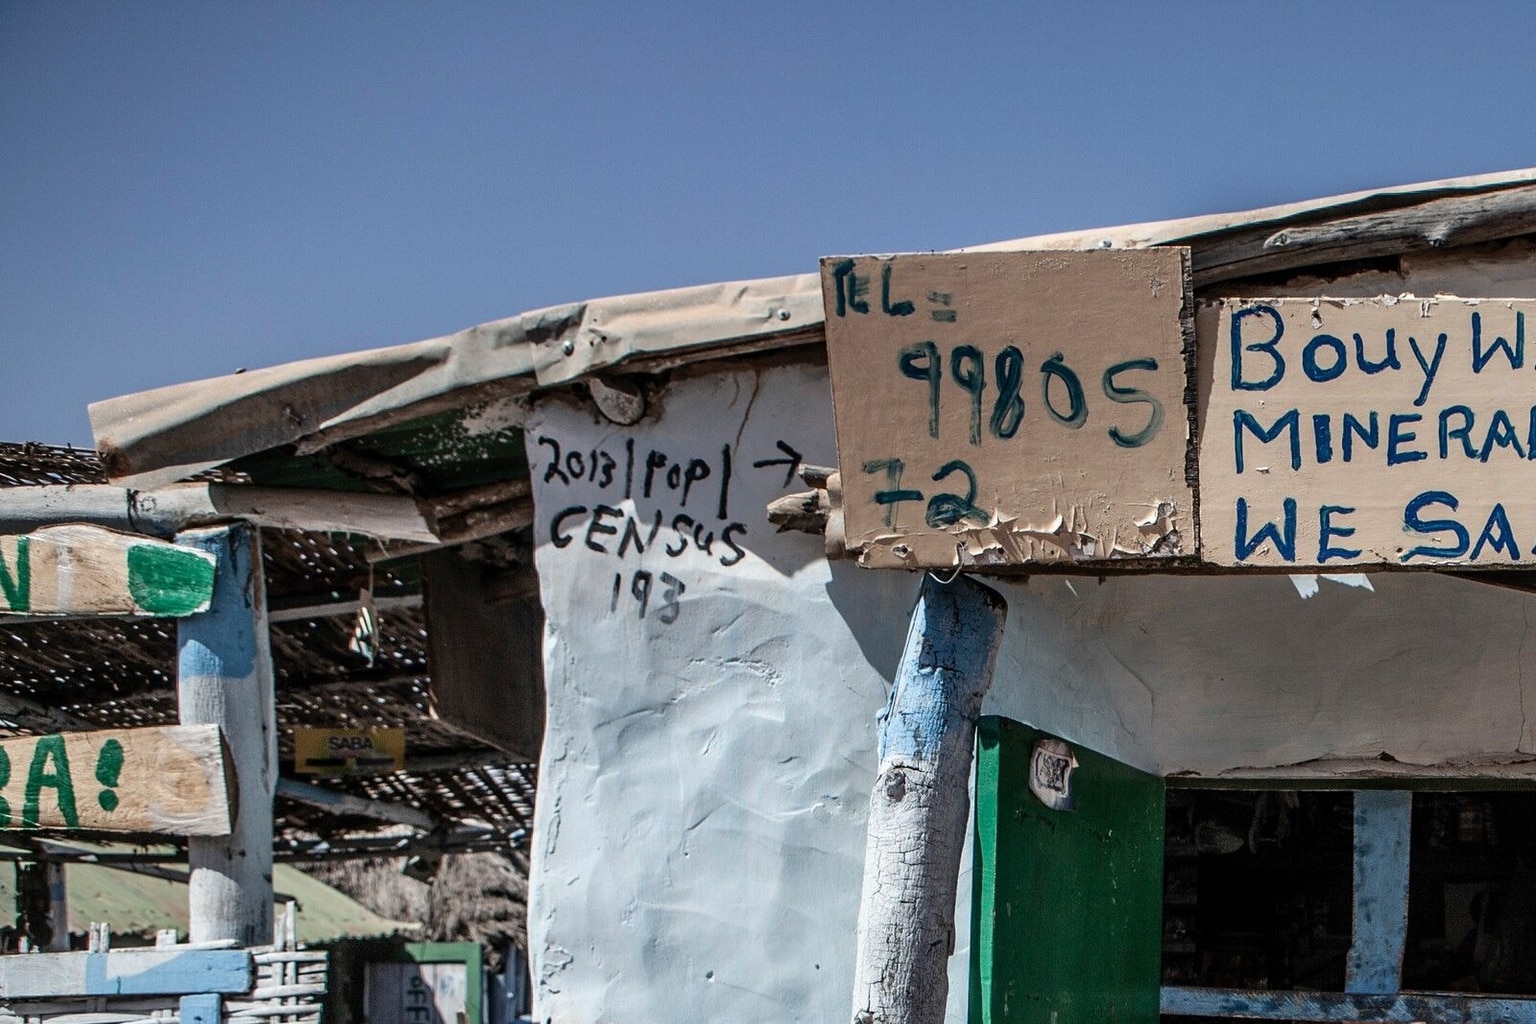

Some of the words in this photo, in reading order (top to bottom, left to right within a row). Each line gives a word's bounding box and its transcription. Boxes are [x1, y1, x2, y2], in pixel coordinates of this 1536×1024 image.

[1234, 497, 1363, 564] WE
[329, 736, 374, 750] SABA
[0, 733, 124, 829] A!
